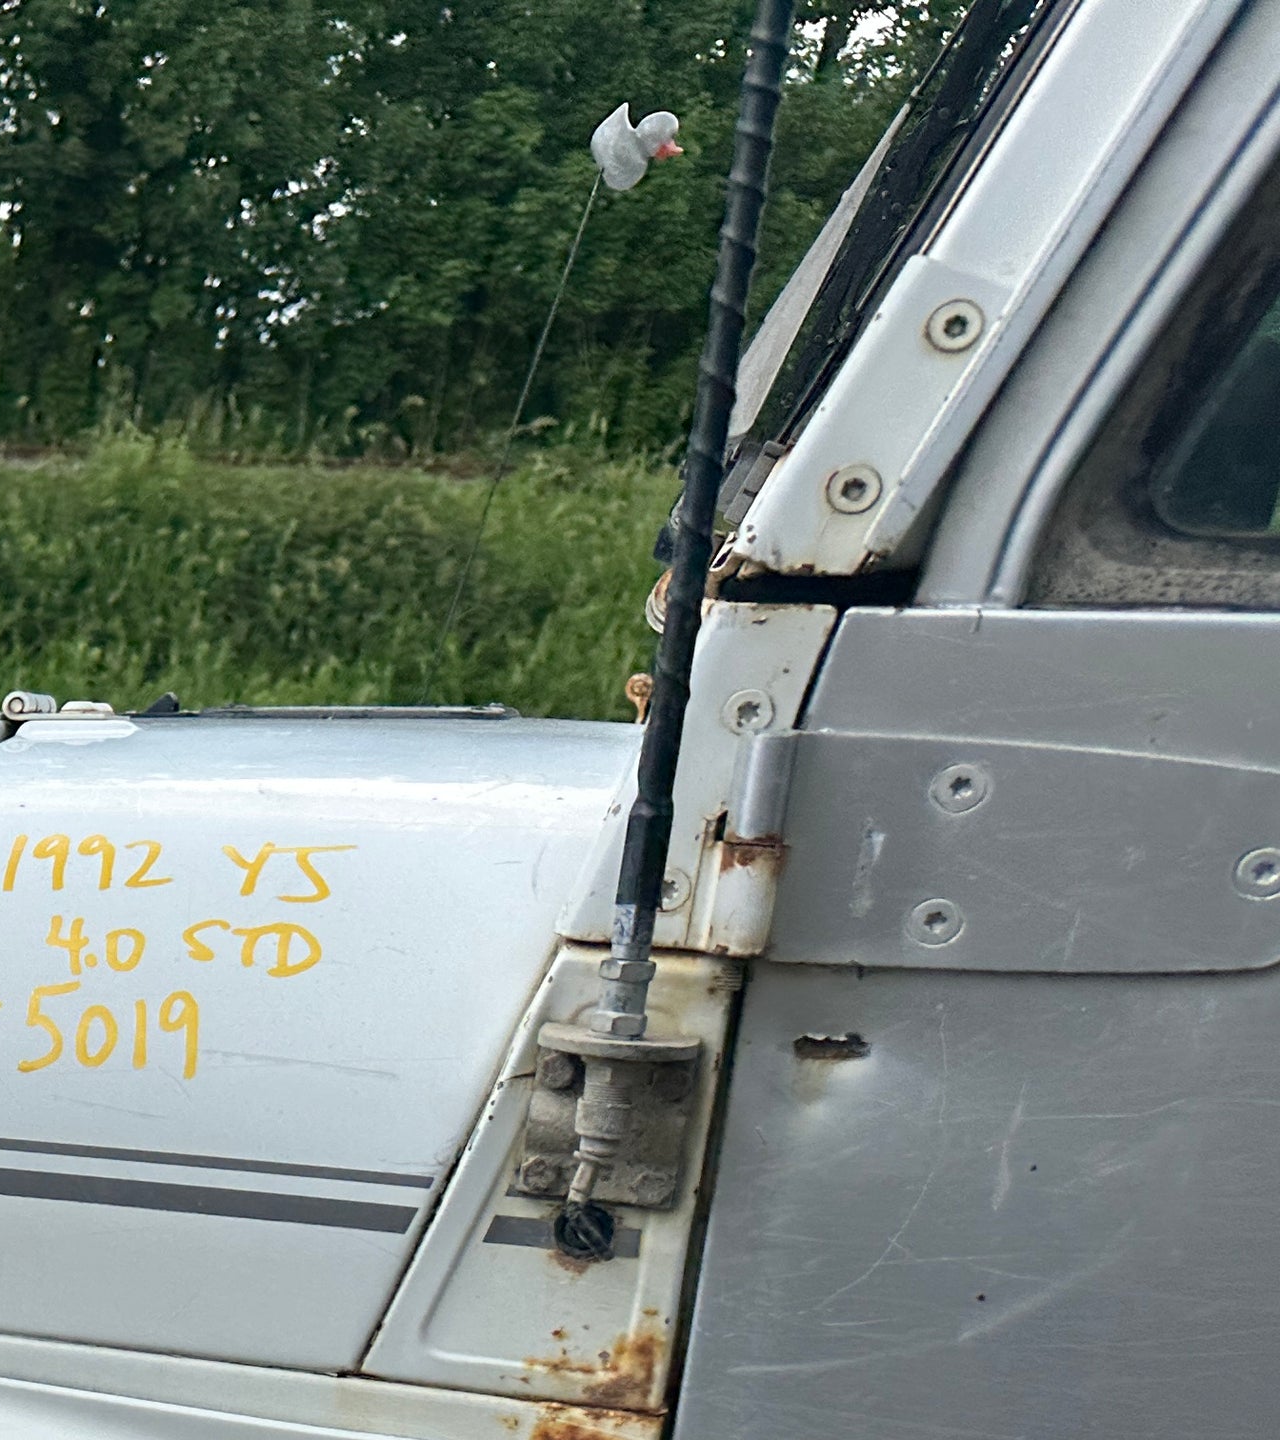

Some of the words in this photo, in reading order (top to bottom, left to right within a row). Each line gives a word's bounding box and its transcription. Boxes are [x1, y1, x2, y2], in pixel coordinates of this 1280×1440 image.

[2, 834, 174, 892] 1992
[45, 915, 146, 976] 4.0
[182, 919, 322, 978] STD
